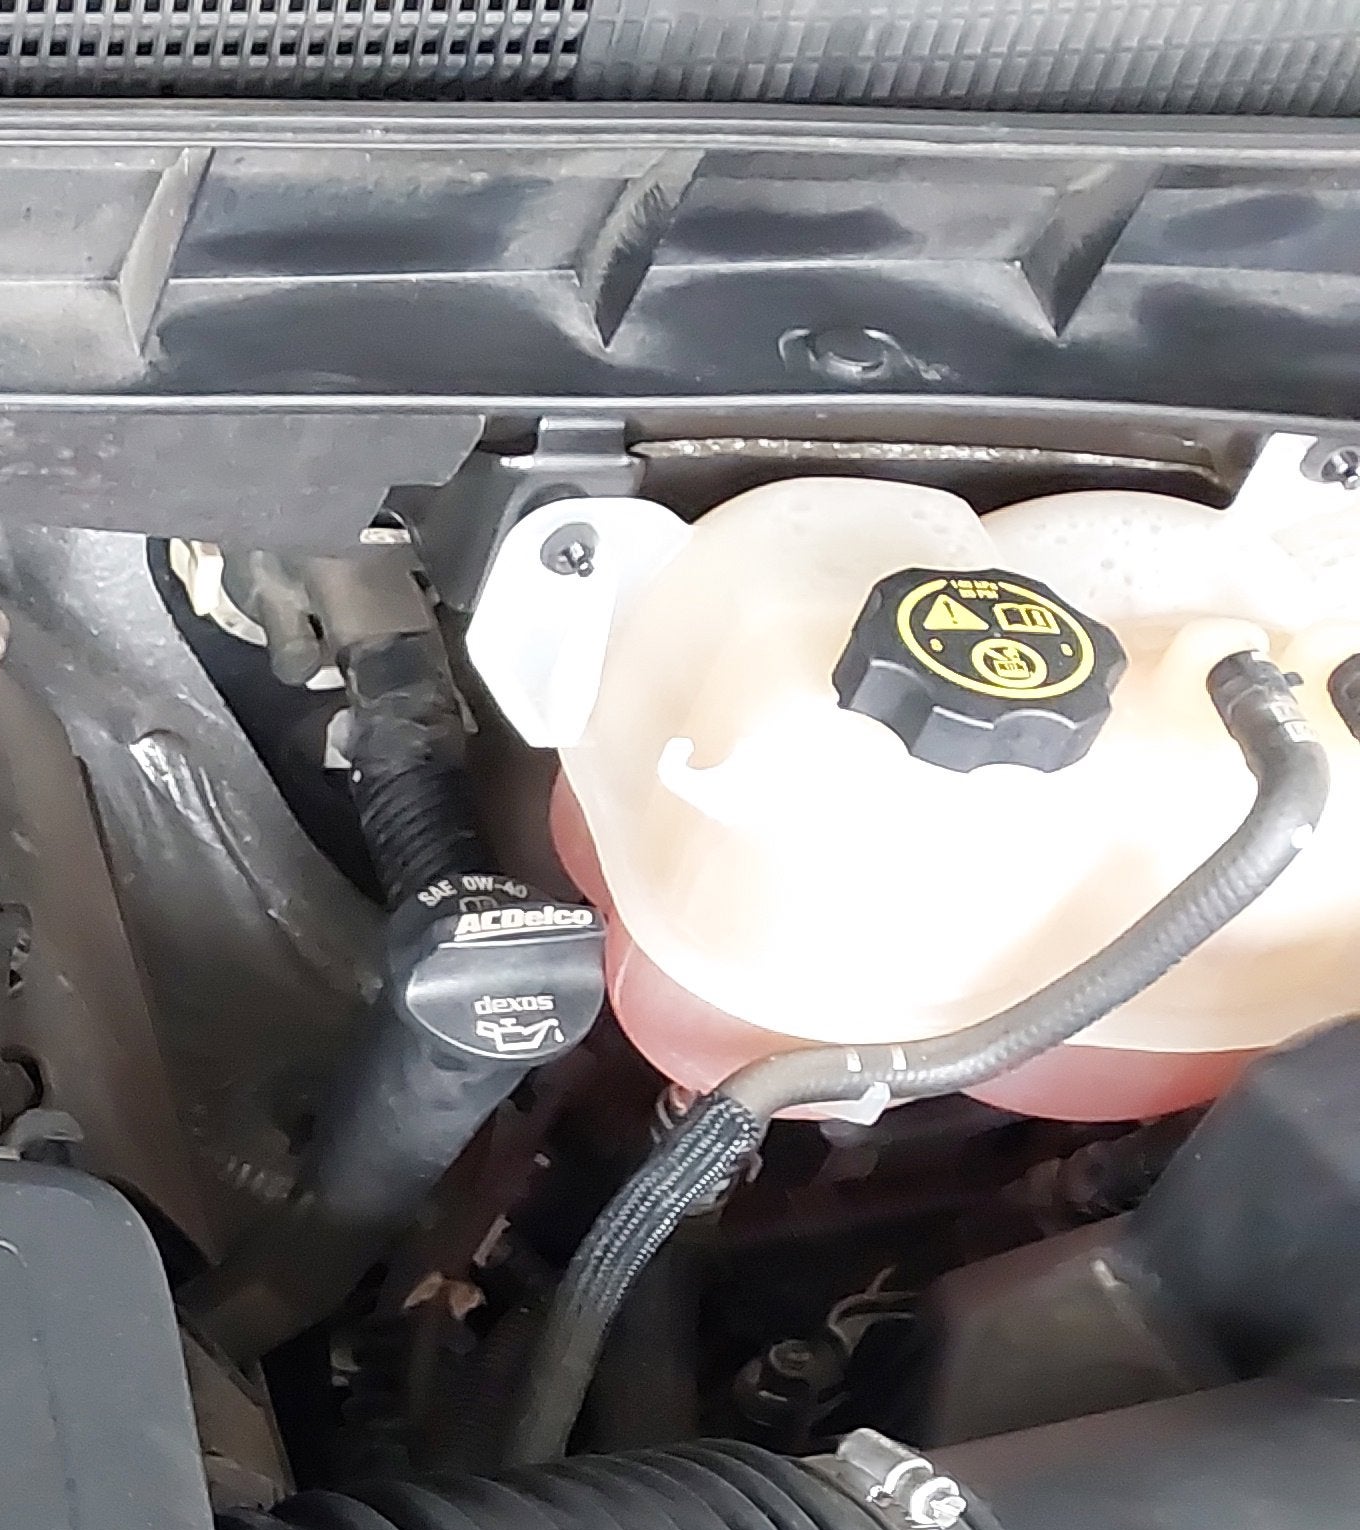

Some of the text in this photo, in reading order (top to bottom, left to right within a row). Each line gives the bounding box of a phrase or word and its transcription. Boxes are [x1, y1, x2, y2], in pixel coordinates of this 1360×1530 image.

[417, 874, 529, 907] SAE 0W-40
[455, 905, 593, 934] ACDelco
[473, 994, 555, 1015] dexos
